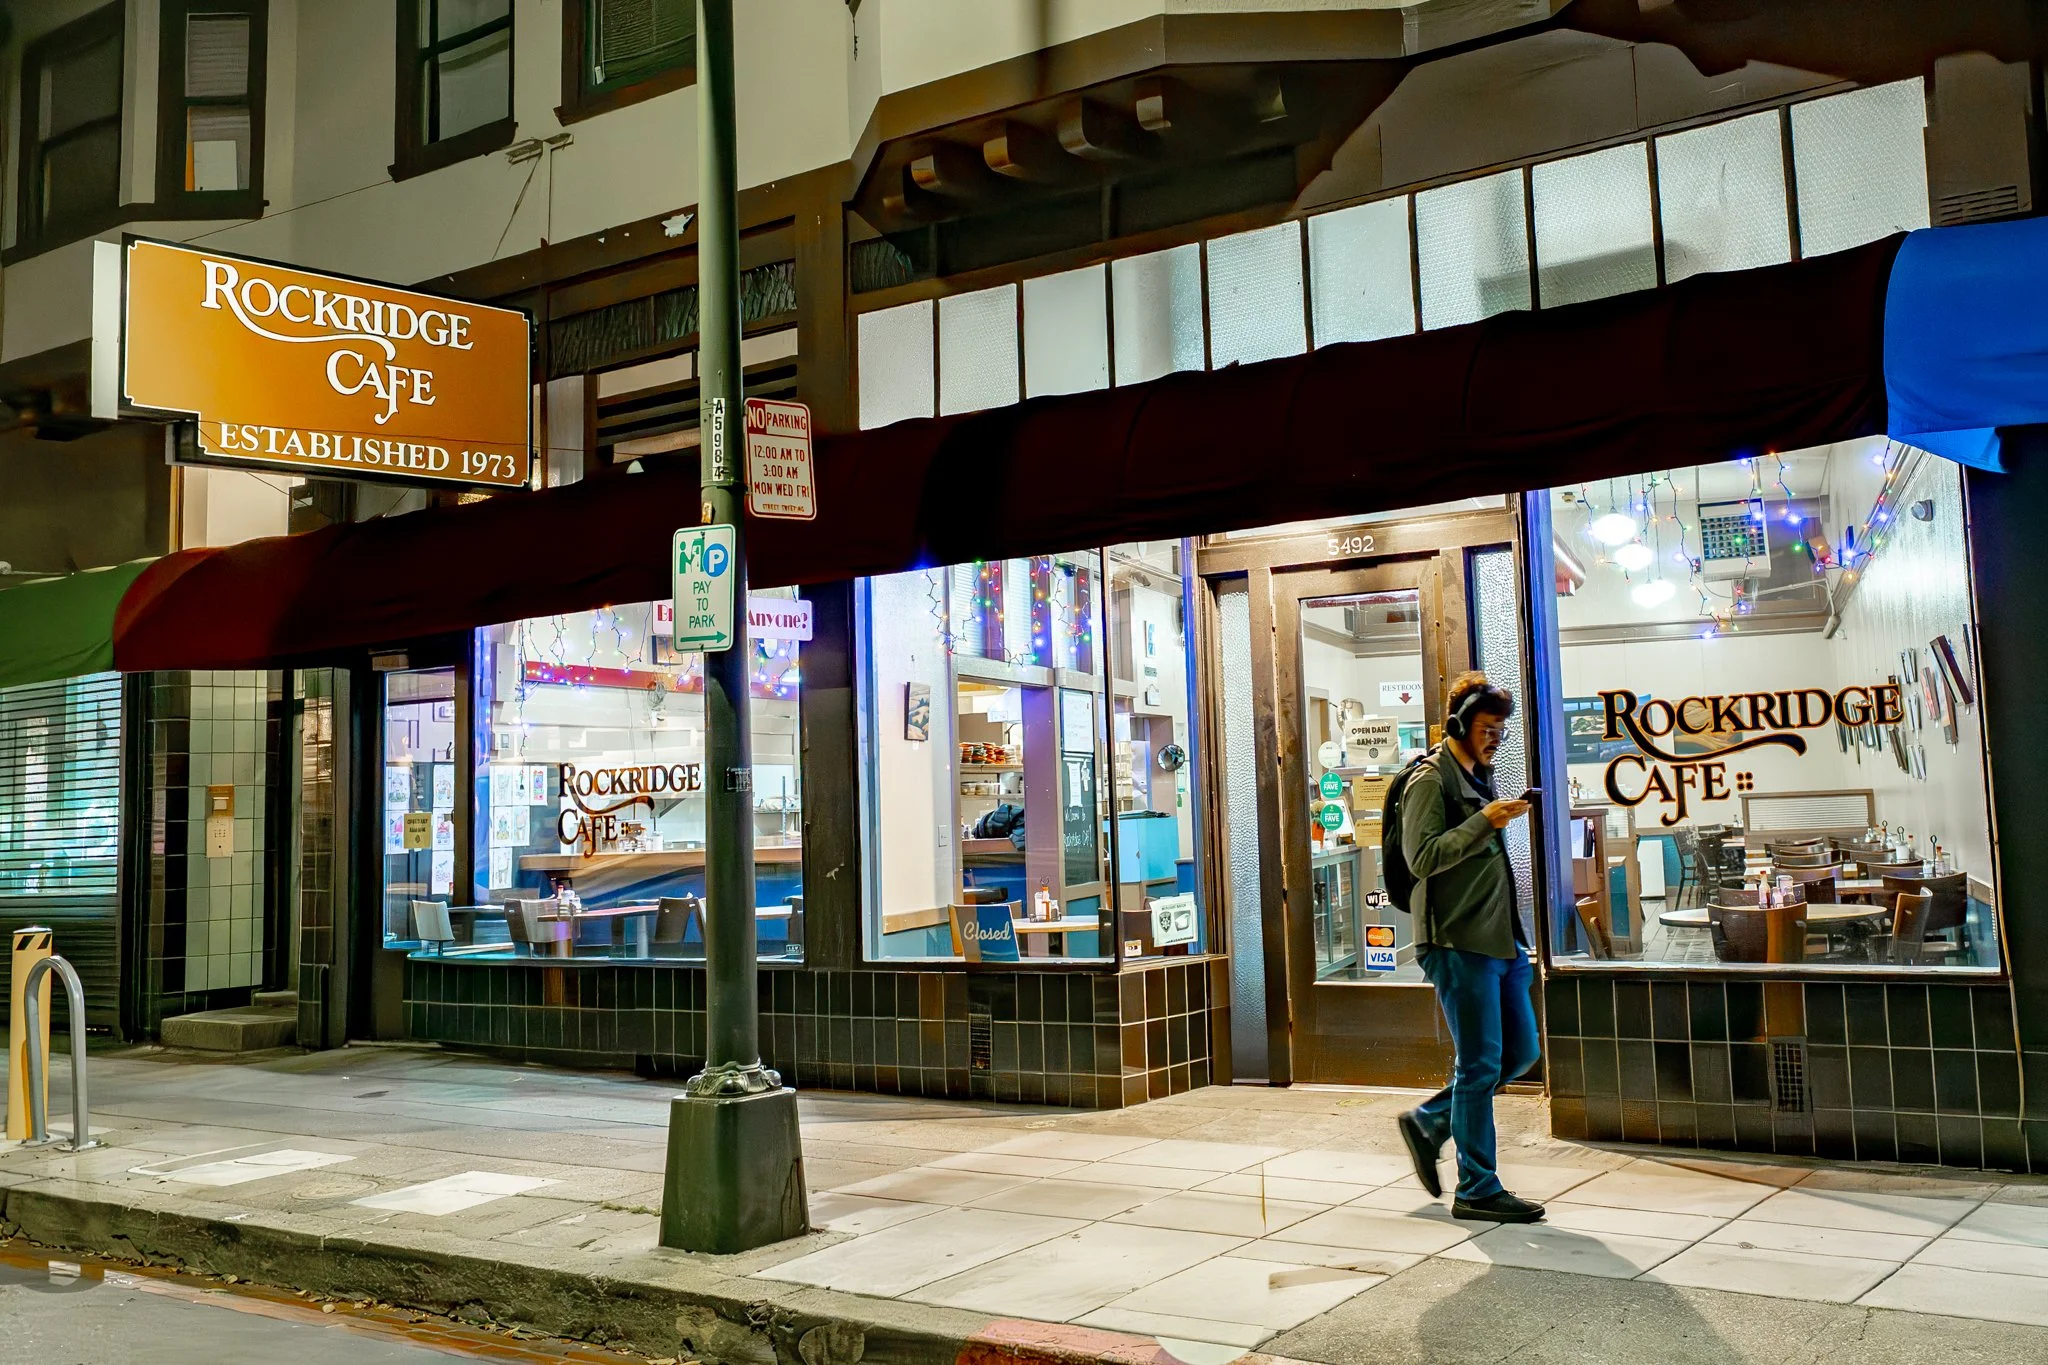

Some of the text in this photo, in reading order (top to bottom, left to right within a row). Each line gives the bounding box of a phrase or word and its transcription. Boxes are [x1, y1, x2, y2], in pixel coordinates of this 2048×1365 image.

[200, 259, 474, 361] ROCKRIDGE
[325, 349, 436, 425] CAFE
[748, 406, 807, 430] NO PARKING
[218, 421, 516, 479] ESTABLISHED 1973
[754, 444, 805, 462] 12:00 AM TO
[763, 464, 799, 479] 3:00 AM
[754, 481, 810, 498] MON WED FRI
[1328, 535, 1375, 556] 5492
[708, 549, 725, 573] P
[693, 580, 712, 594] PAY
[696, 598, 709, 611] TO
[689, 614, 715, 628] PARK
[748, 609, 808, 629] Anyone?
[1351, 725, 1391, 735] OPEN DAILY
[1598, 683, 1905, 762] ROCKRIDGE
[558, 762, 702, 815] ROCKRIDGE
[1324, 783, 1338, 791] FAVE
[1603, 755, 1731, 827] CAFE
[1325, 815, 1340, 823] FAVE
[557, 808, 618, 859] CAFE
[963, 920, 1011, 940] Closed
[1370, 953, 1394, 963] VISA
